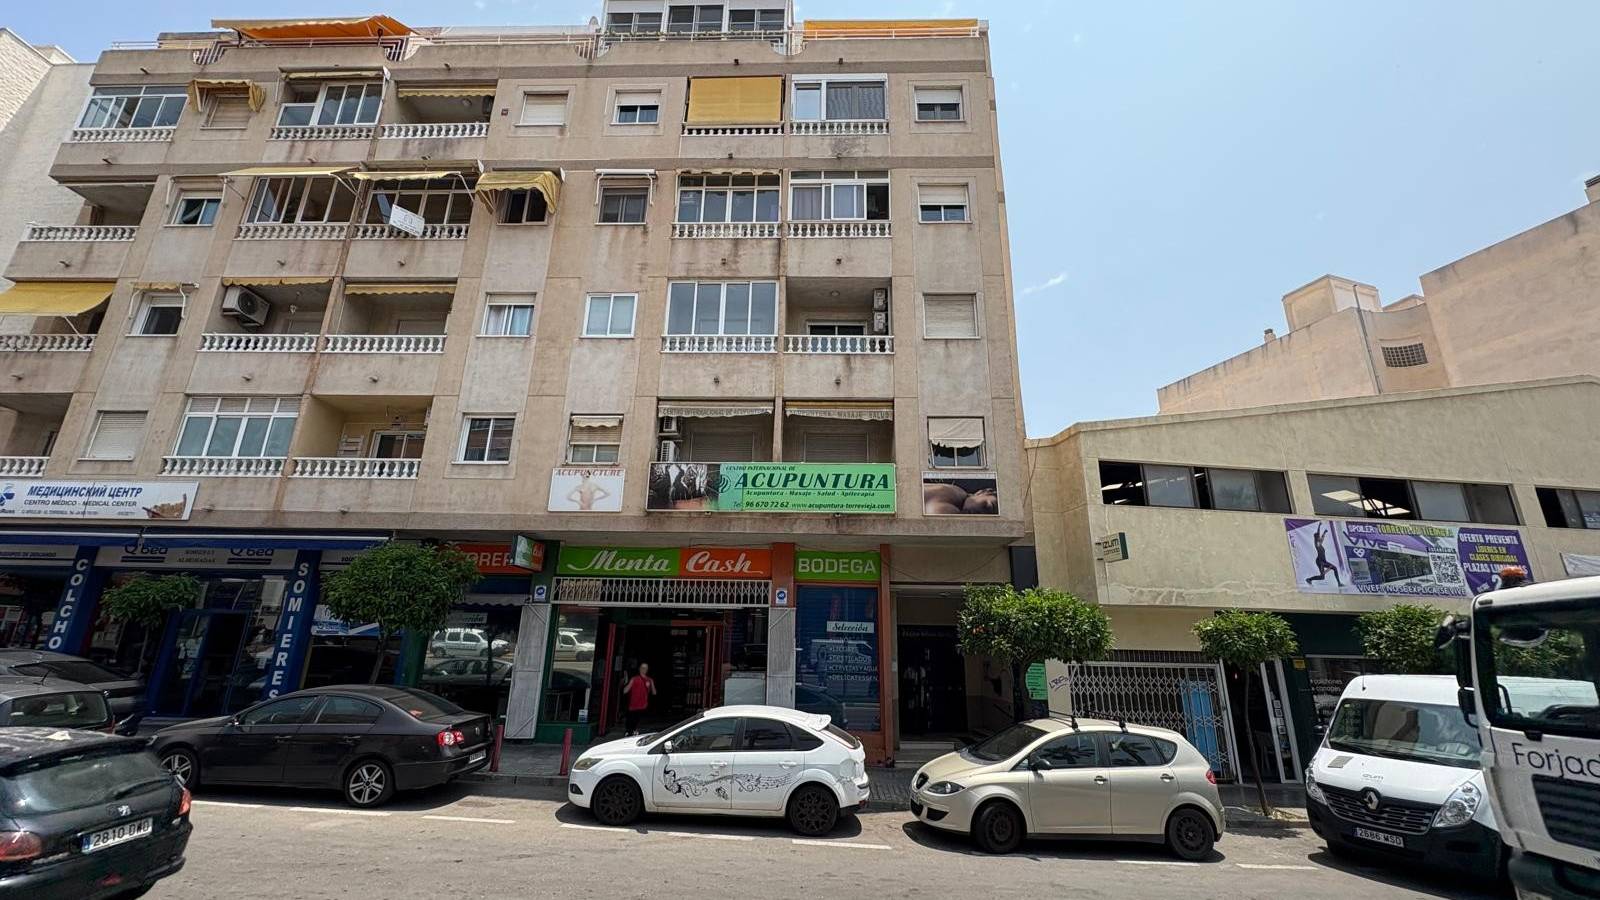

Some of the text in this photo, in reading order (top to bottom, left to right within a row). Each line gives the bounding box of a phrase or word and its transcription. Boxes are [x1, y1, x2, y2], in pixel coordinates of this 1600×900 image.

[734, 472, 889, 490] ACUPUNTURA
[27, 485, 143, 499] МЕДИЦИНСКИЙ ЦЕНТР
[1459, 533, 1520, 546] OFERTA PREVENTA
[567, 549, 673, 571] Menta
[685, 550, 763, 575] Cash
[798, 558, 877, 575] BODEGA
[1462, 562, 1491, 573] PLAZAS
[268, 562, 310, 700] SOMIERES
[832, 622, 869, 632] Selección
[93, 827, 125, 847] 2810
